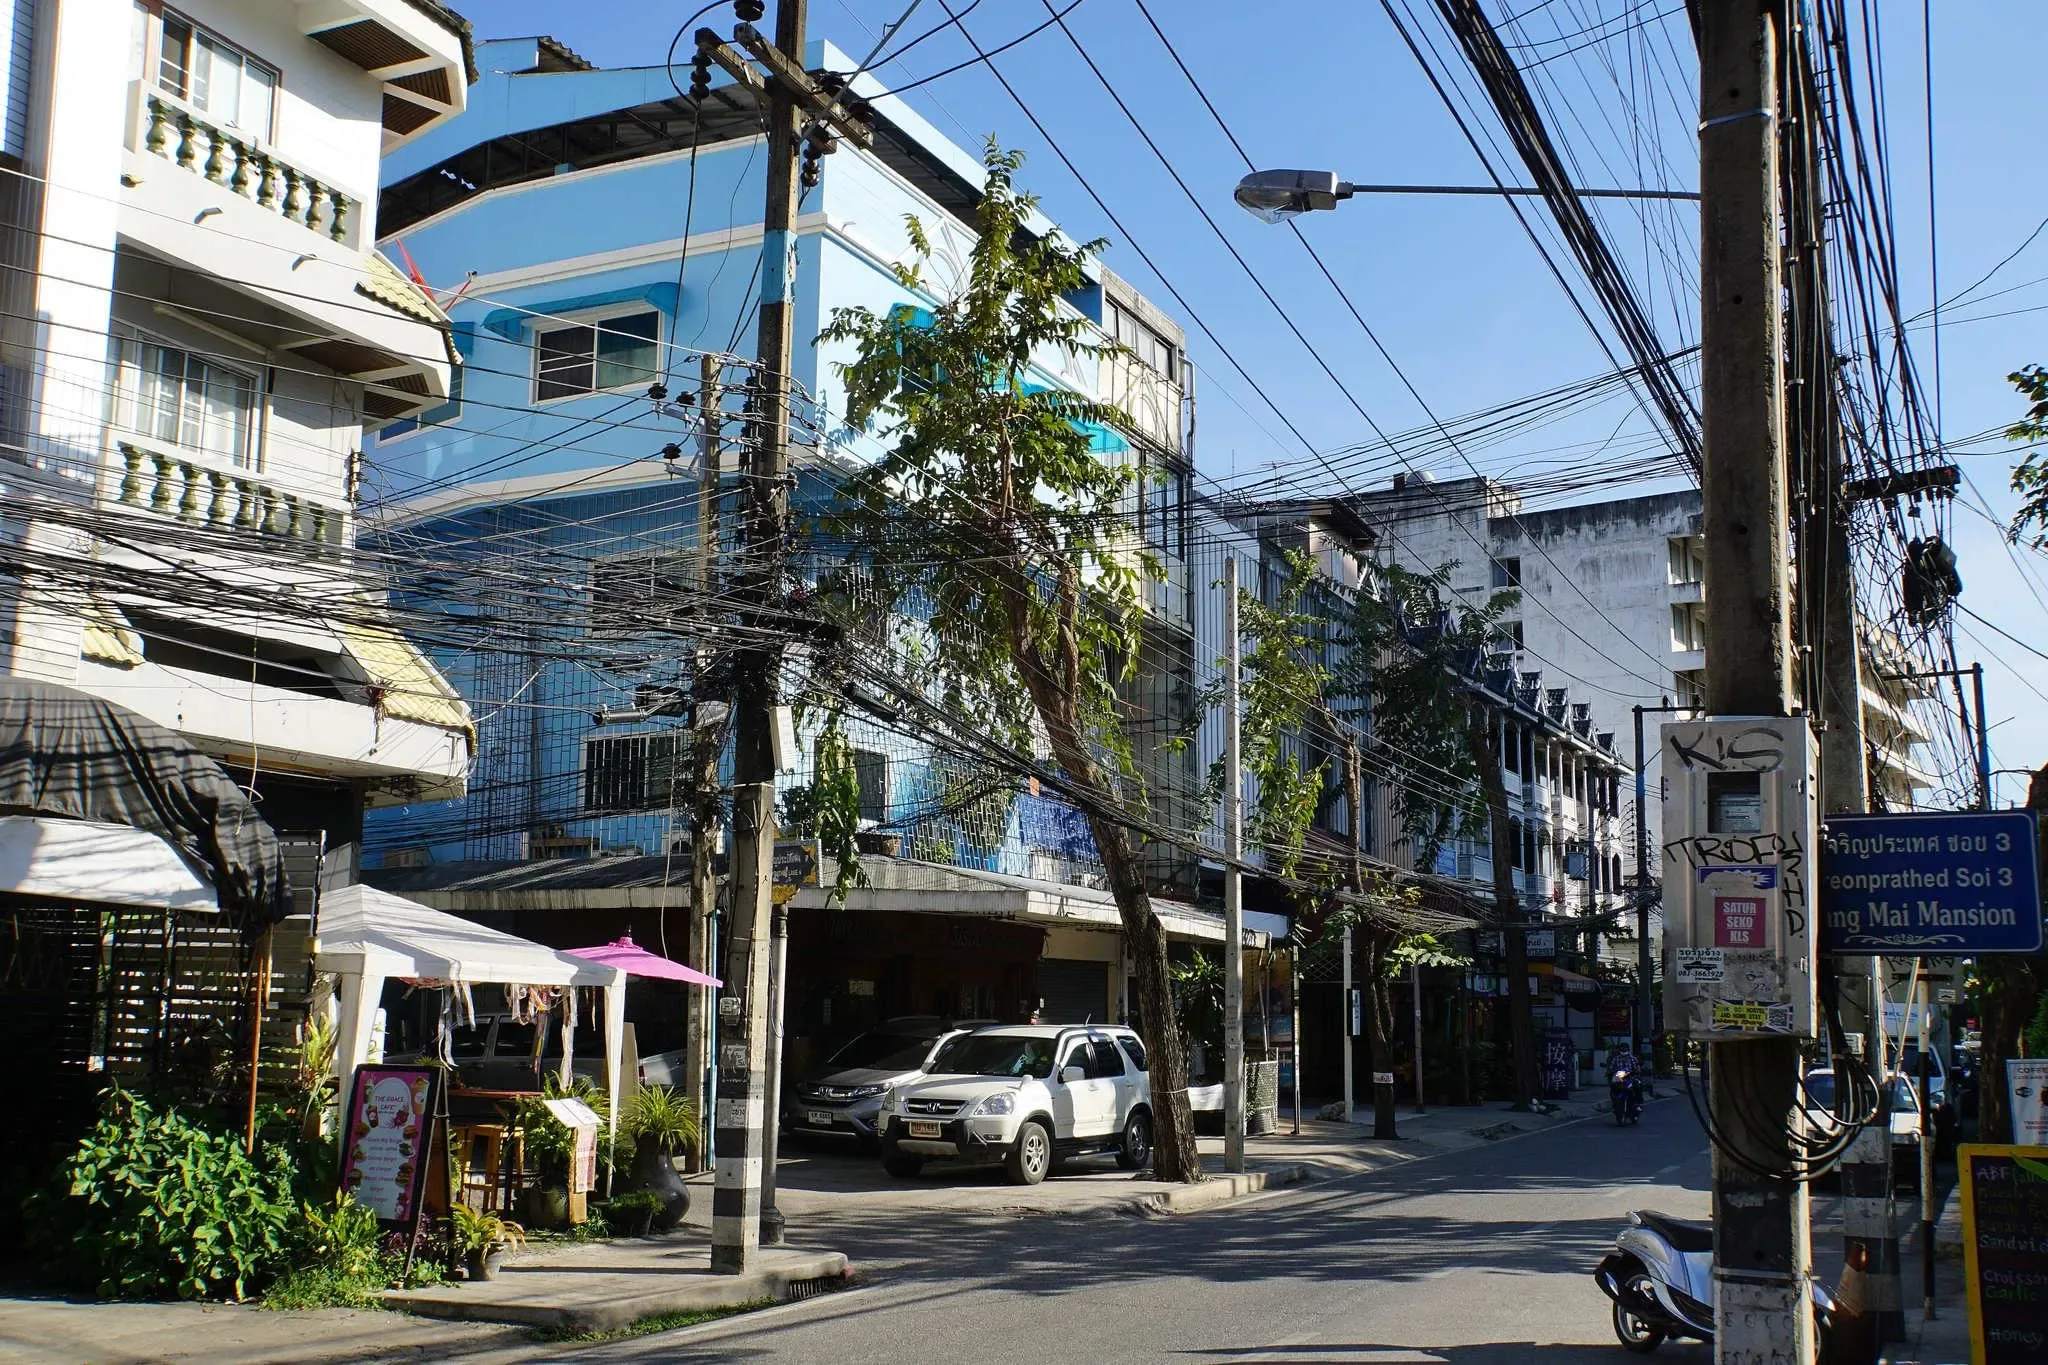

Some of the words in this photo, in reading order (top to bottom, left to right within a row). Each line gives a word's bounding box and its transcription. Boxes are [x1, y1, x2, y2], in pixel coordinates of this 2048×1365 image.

[1948, 835, 1988, 852] ซอย
[1995, 833, 2011, 852] 3
[1955, 867, 1992, 888] Soi
[1998, 868, 2013, 887] 3
[1869, 903, 1911, 928] Mai
[1918, 900, 2016, 928] Mansion
